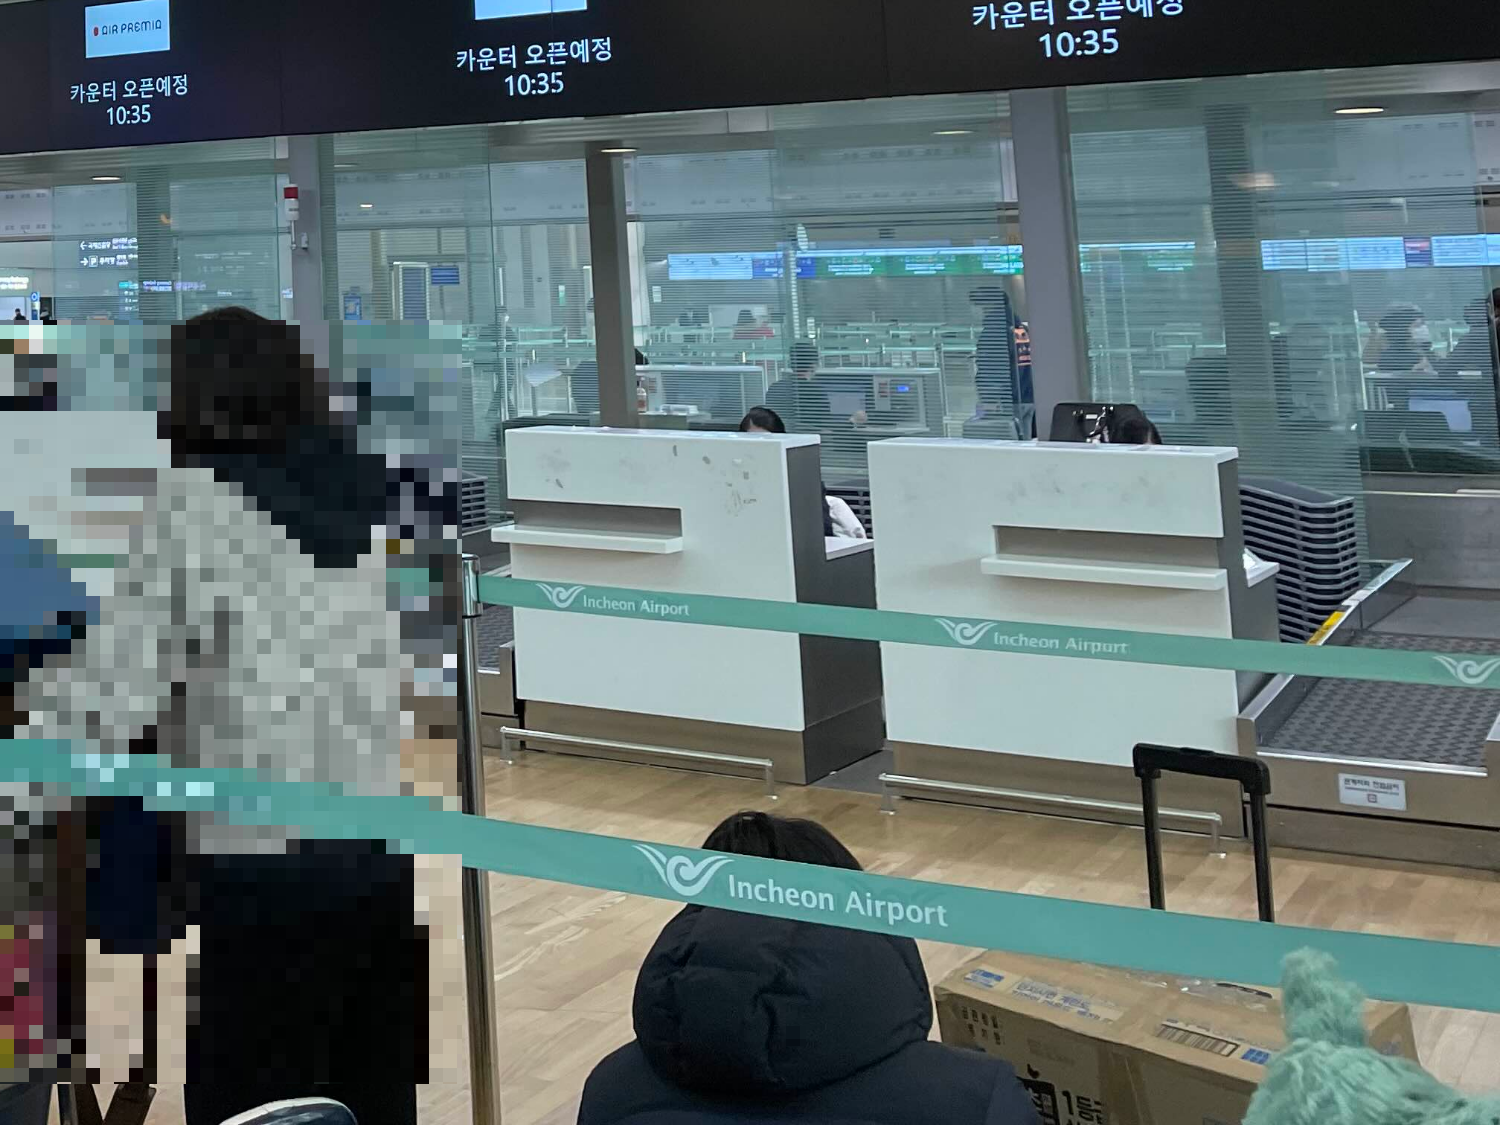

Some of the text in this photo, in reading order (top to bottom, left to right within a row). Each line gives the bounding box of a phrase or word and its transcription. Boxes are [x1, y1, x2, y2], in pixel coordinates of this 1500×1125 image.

[102, 19, 162, 36] AIR PREMIA
[456, 36, 612, 72] 카운터 오픈예정
[1038, 28, 1120, 58] 10:35
[70, 73, 188, 104] 카운터 오픈예정
[504, 71, 564, 96] 10:35
[106, 104, 151, 125] 10:35
[582, 593, 690, 618] Incheon Airport
[993, 632, 1129, 656] Incheon Airport
[728, 874, 949, 927] Incheon Airport
